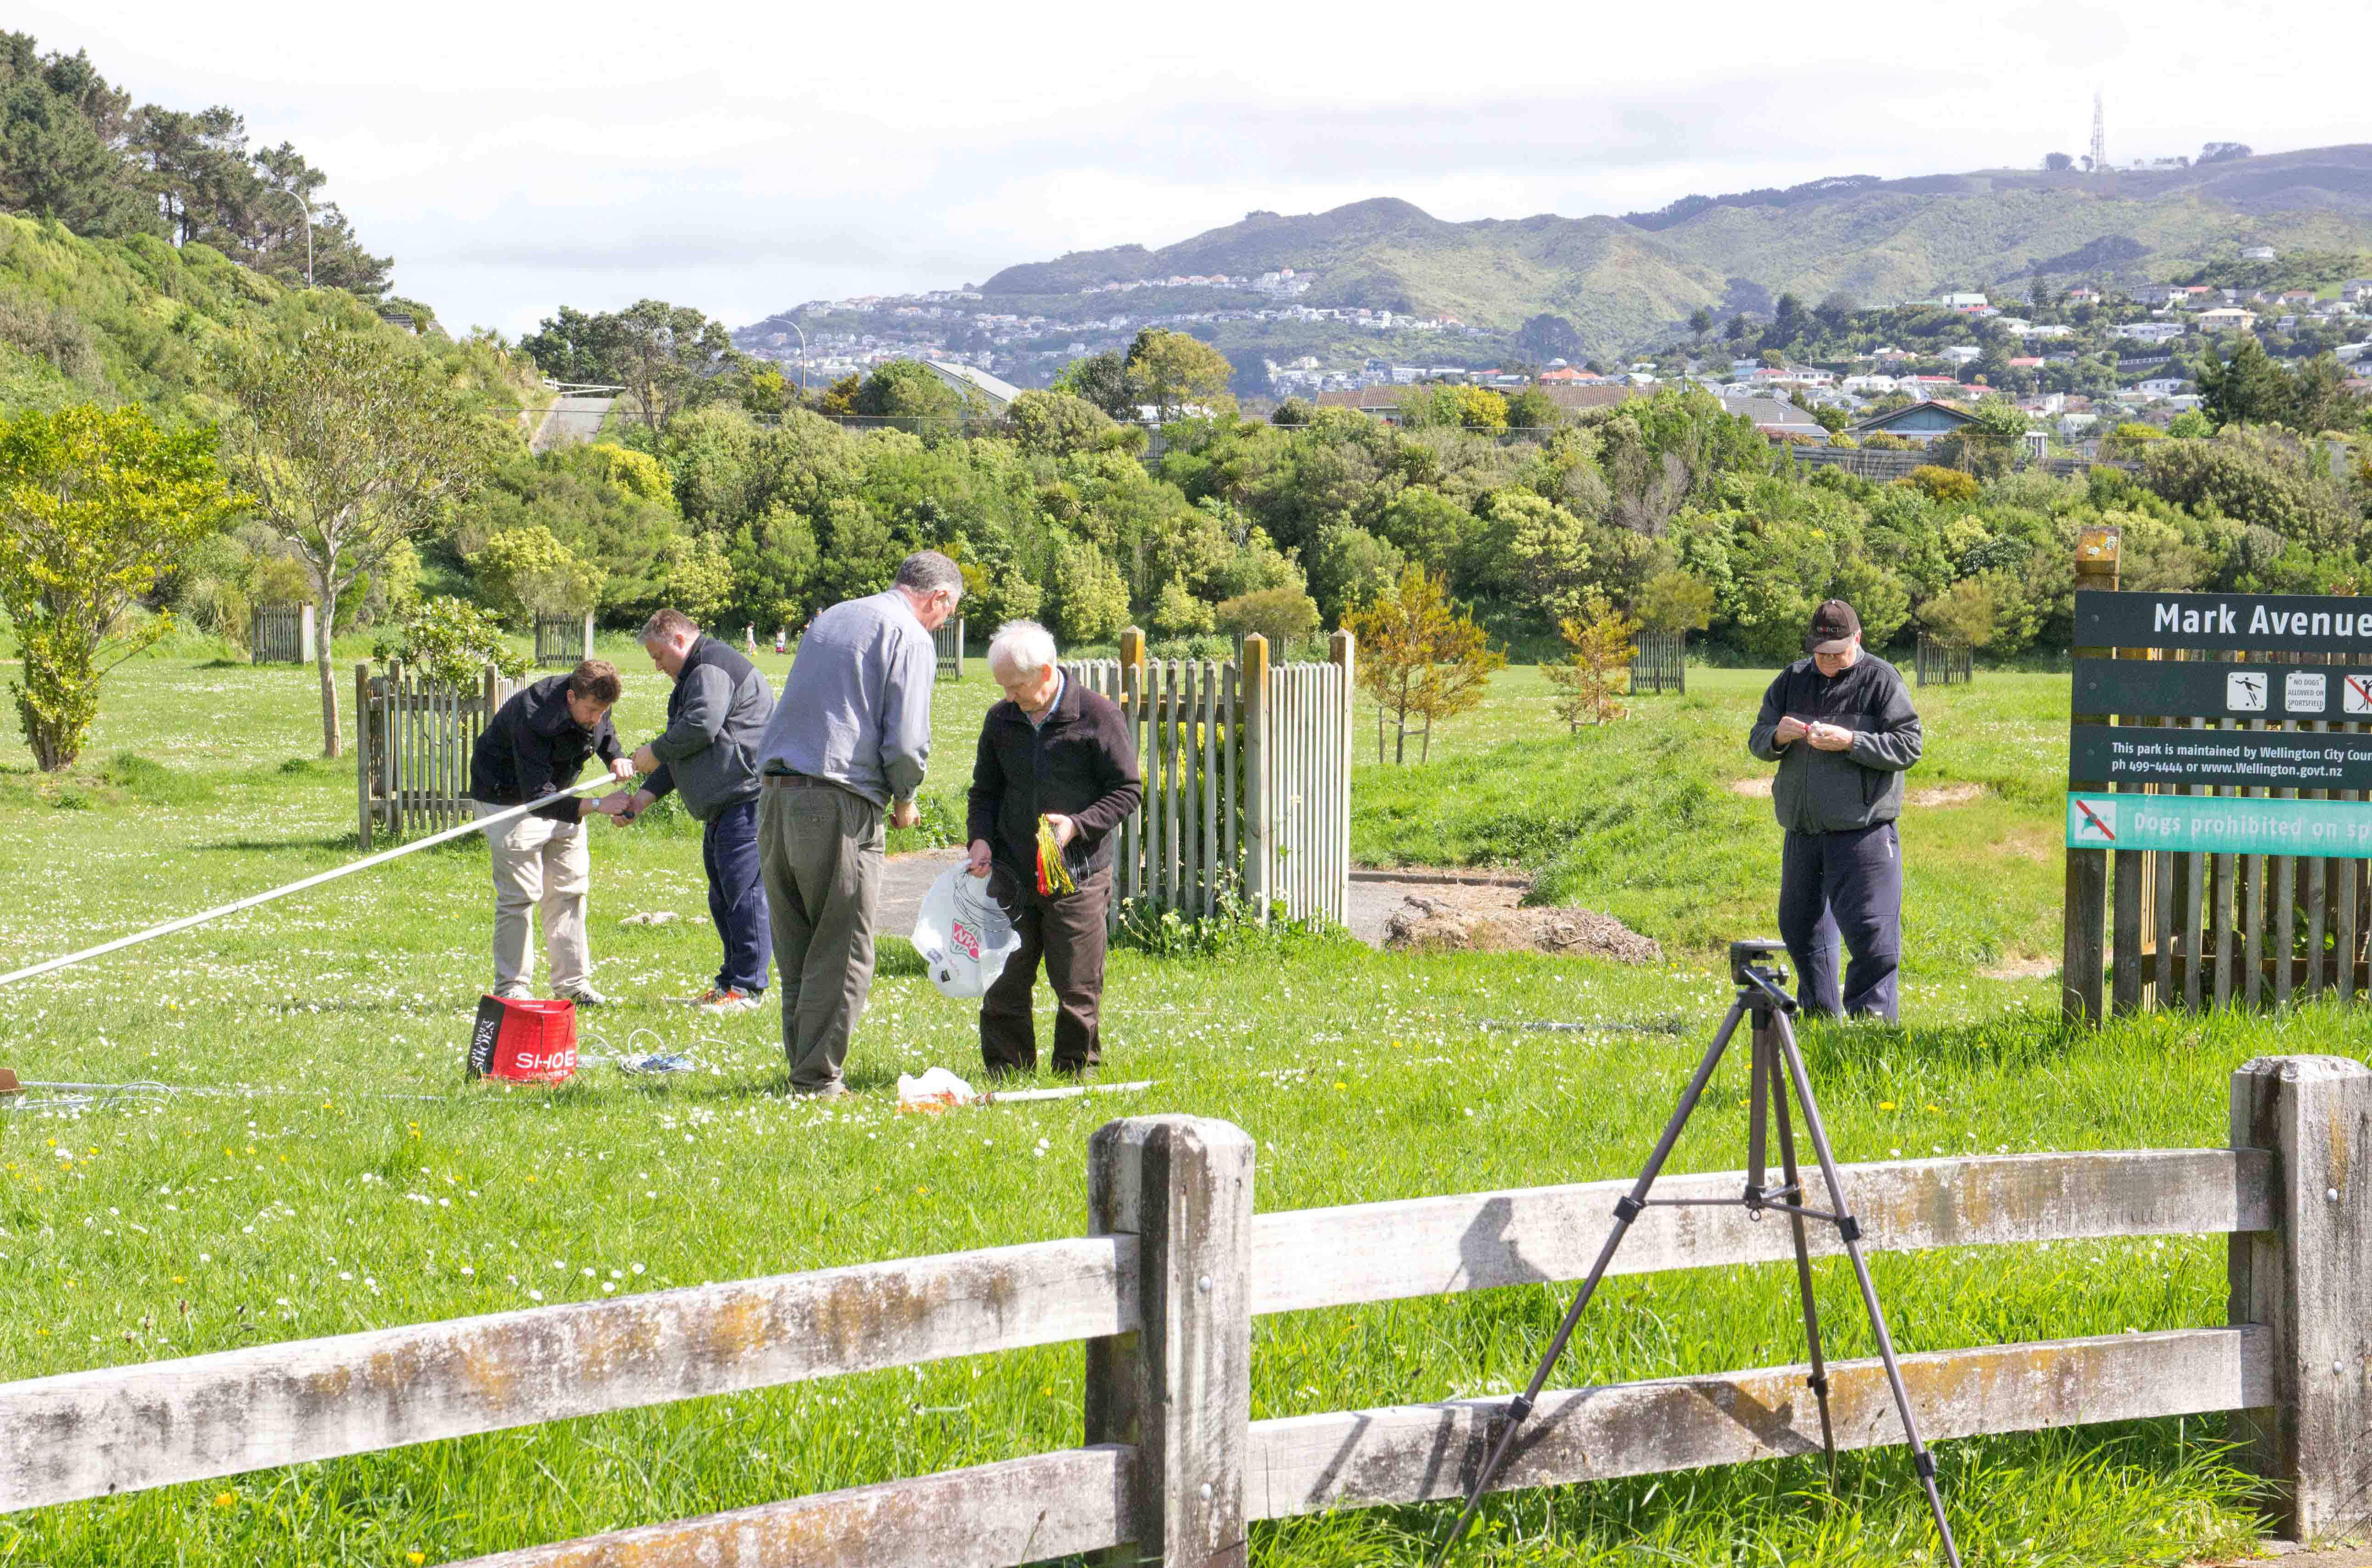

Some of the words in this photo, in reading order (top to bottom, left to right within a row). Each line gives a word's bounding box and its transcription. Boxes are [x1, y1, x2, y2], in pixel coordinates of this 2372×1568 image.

[2154, 603, 2237, 633] Mark
[2249, 605, 2372, 637] Avenue
[2112, 742, 2134, 753] This
[2137, 743, 2161, 756] park
[2165, 743, 2173, 755] is
[2177, 744, 2240, 757] maintained
[2244, 746, 2257, 760] by
[2260, 747, 2320, 761] Wellington
[2324, 748, 2344, 762] City
[2112, 759, 2126, 772] ph
[2129, 761, 2183, 773] 499-4444
[2186, 762, 2198, 772] or
[2202, 762, 2343, 778] www.Wellington.govt.nz
[2134, 812, 2181, 836] Dogs
[2191, 815, 2303, 839] prohibited
[2313, 822, 2337, 838] on
[515, 1050, 575, 1069] SHOE
